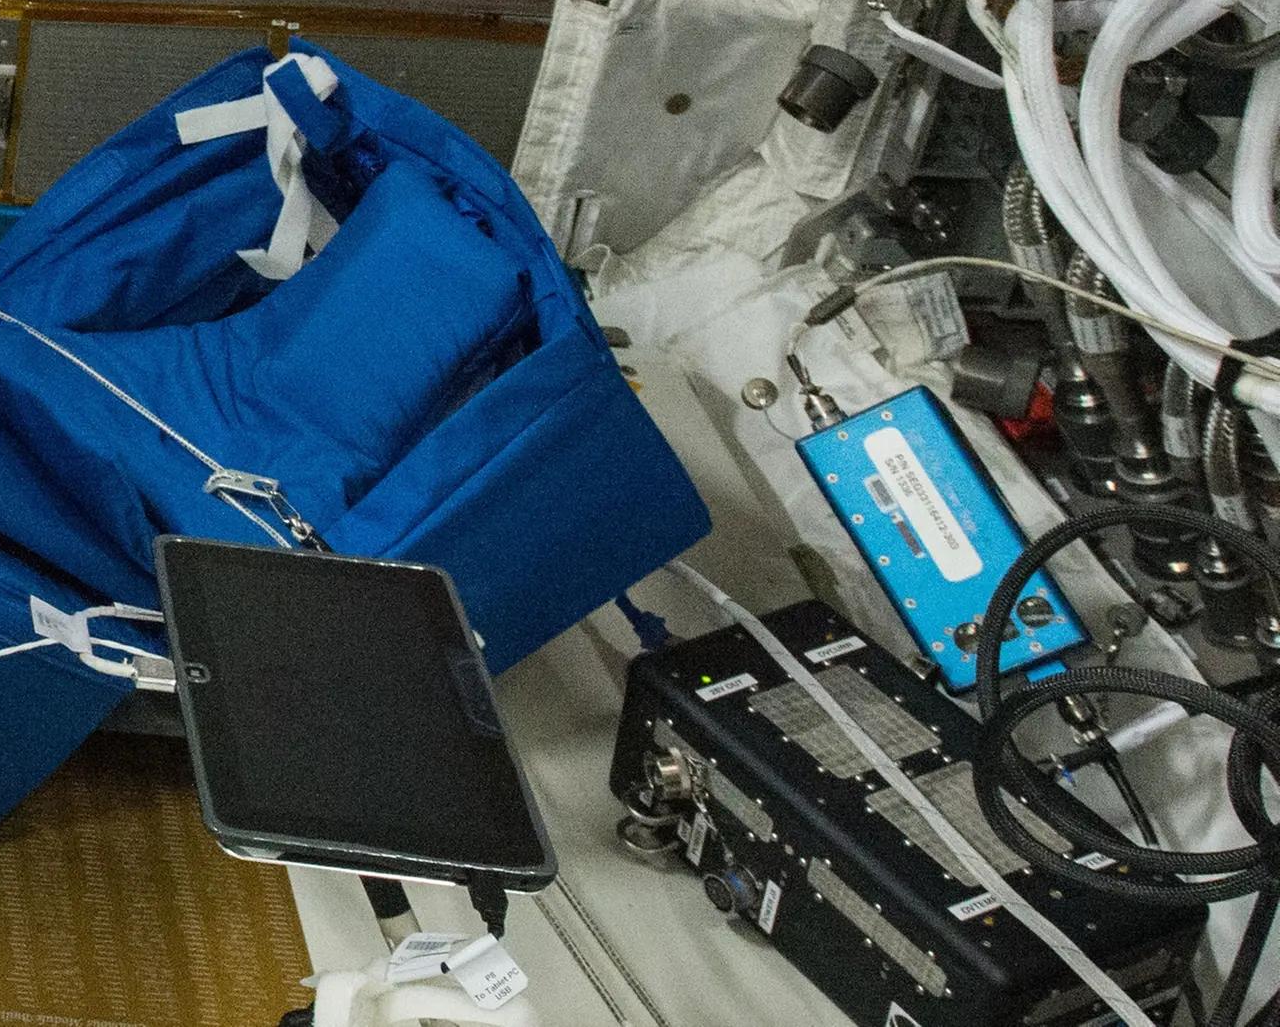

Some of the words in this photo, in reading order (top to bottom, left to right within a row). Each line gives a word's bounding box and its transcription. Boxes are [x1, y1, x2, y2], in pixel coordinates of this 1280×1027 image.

[884, 457, 899, 476] S/N
[894, 453, 911, 472] P/N
[474, 992, 486, 1002] To
[485, 975, 509, 994] Tablet
[508, 967, 520, 979] PC
[495, 986, 512, 1001] USB
